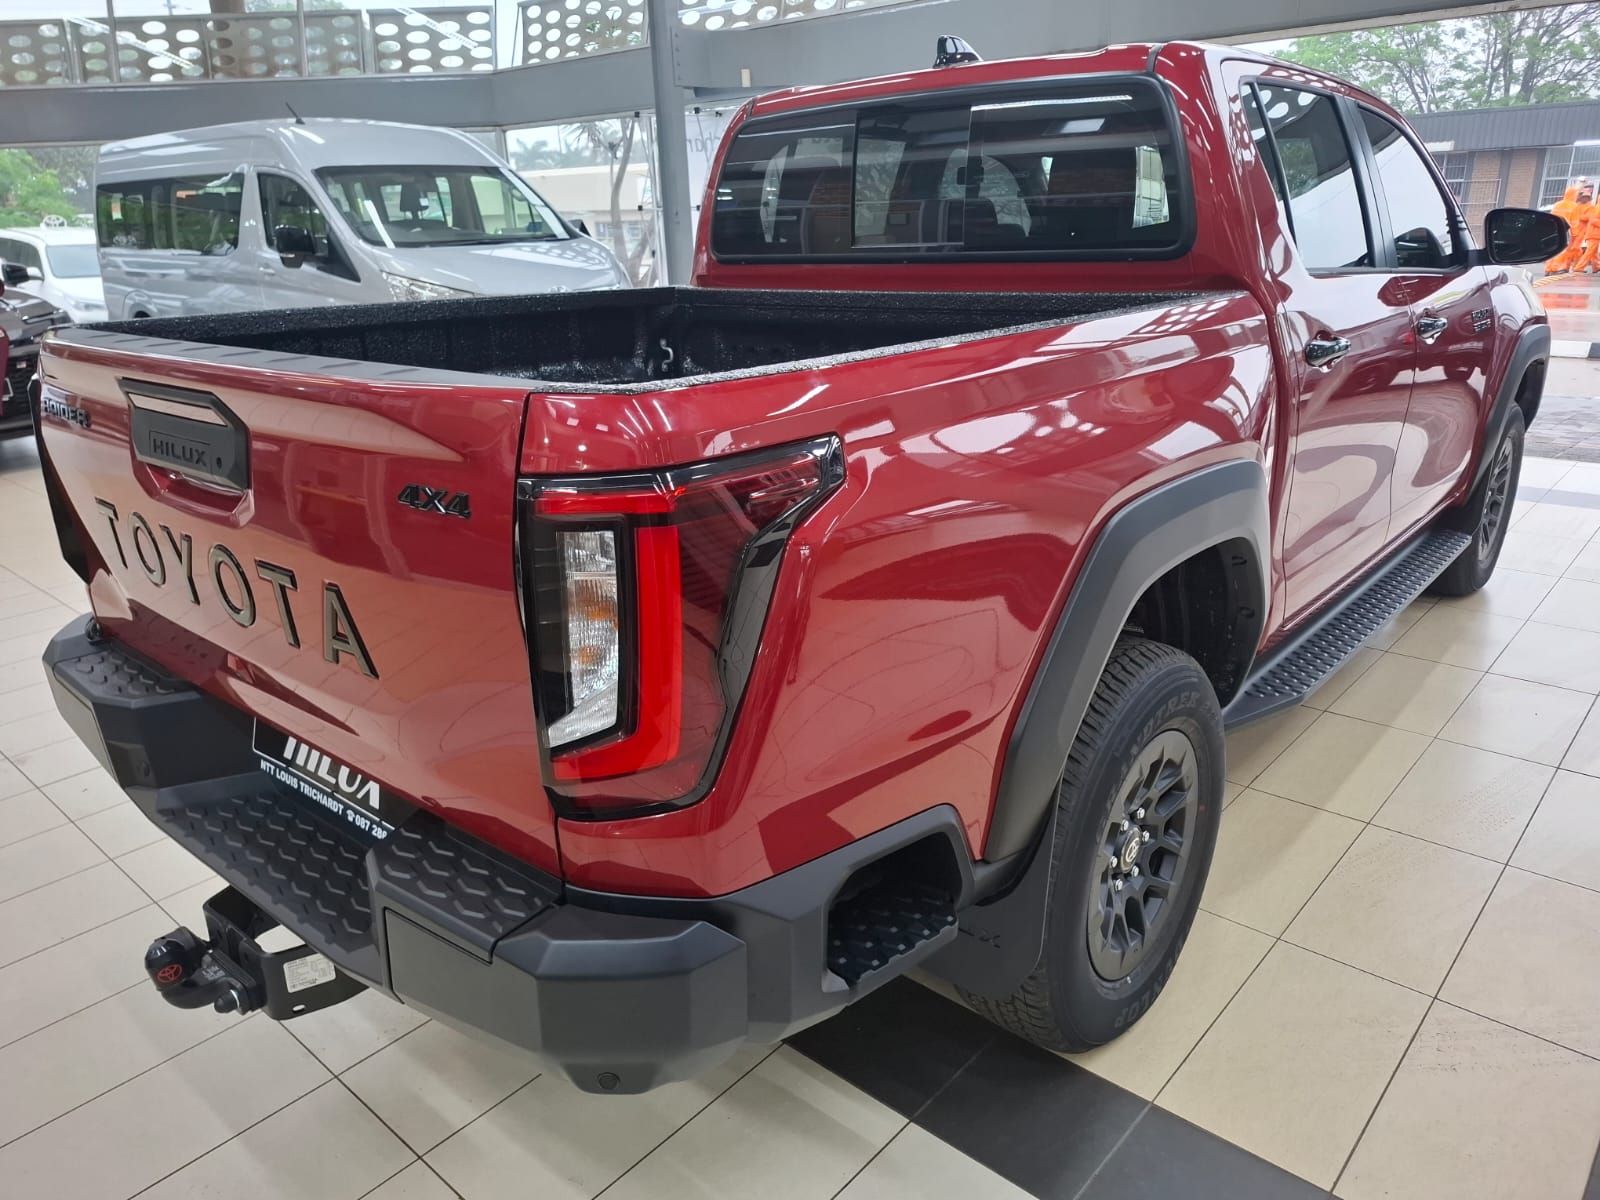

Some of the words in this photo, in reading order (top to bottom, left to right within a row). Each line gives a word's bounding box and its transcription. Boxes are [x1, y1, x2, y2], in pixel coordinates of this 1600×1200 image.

[152, 438, 207, 467] HILUX
[94, 496, 379, 680] TOYOTA
[260, 759, 275, 774] NTT
[276, 769, 298, 789] LOUIS
[299, 781, 344, 816] TRICHARDT
